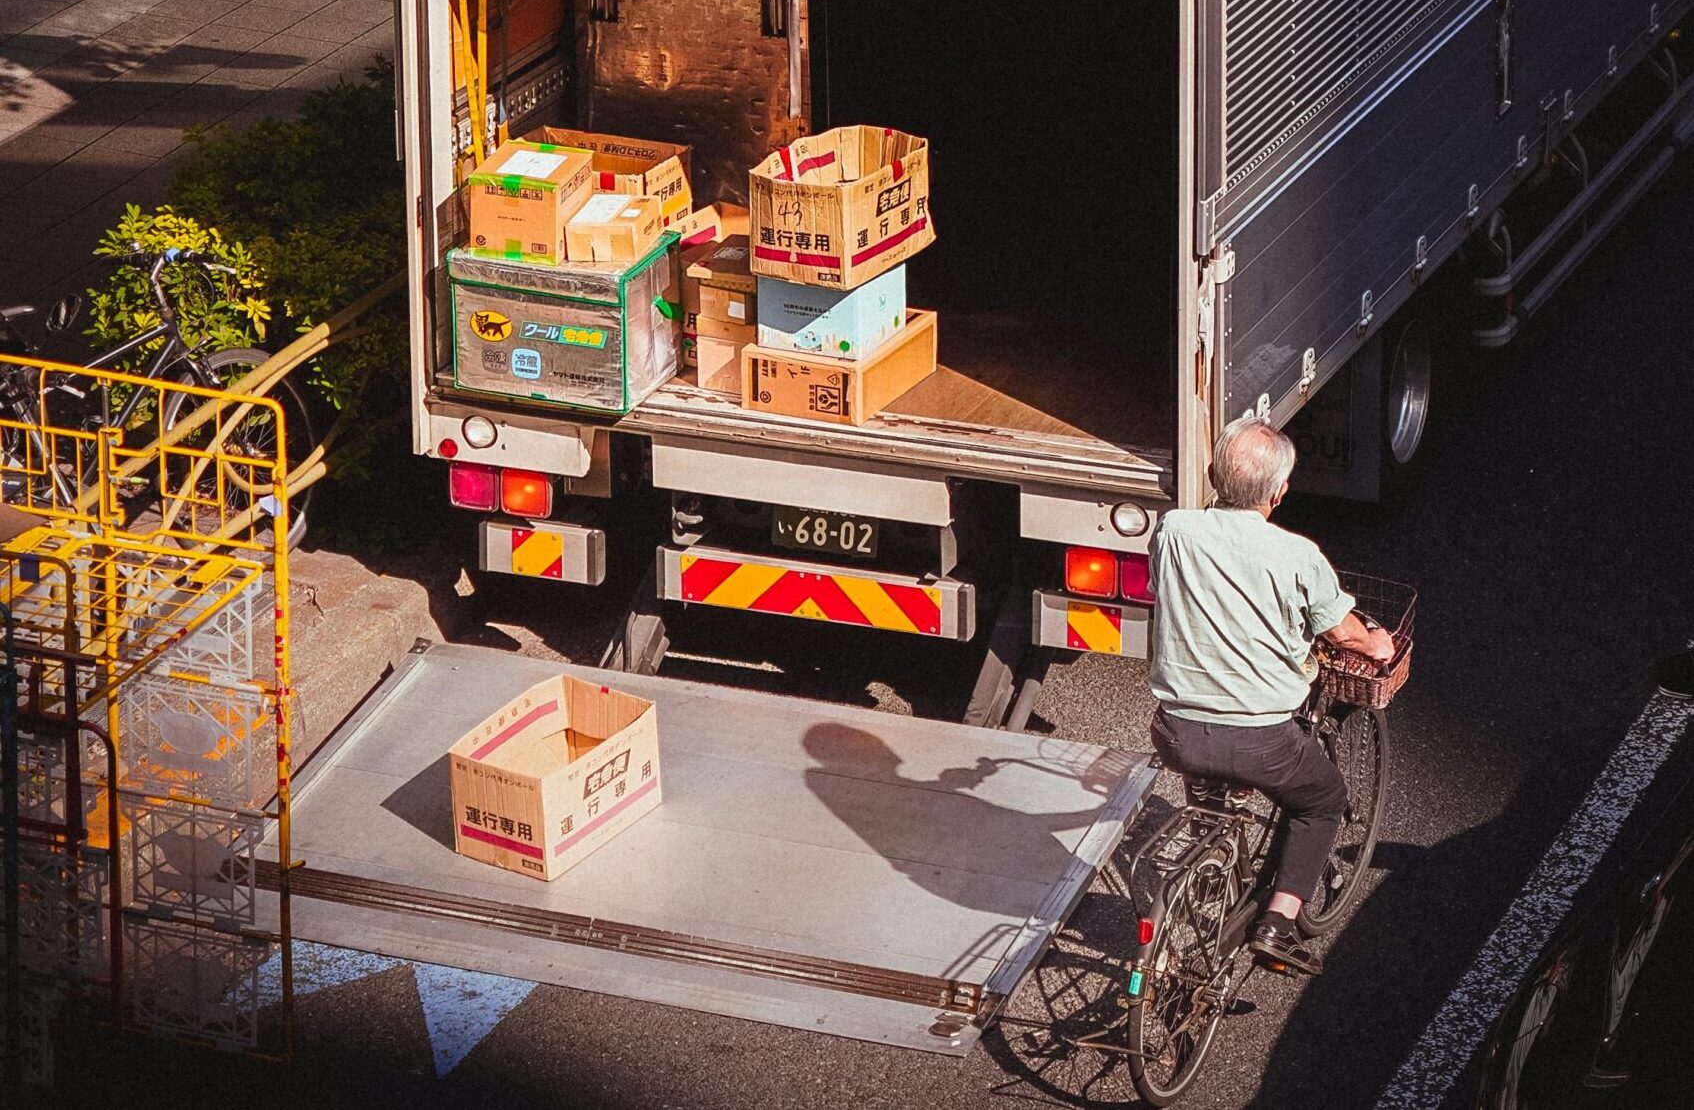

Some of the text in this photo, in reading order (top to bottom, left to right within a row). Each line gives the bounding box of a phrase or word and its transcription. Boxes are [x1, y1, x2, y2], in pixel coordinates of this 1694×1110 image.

[777, 200, 803, 227] 43
[878, 179, 912, 213] 宅急便
[760, 226, 831, 253] 運行専用
[857, 195, 927, 250] 運行専用
[778, 515, 873, 554] い 68-02
[586, 751, 630, 797] 宅急便
[560, 759, 652, 837] 運行専用
[464, 804, 533, 842] 運行専用
